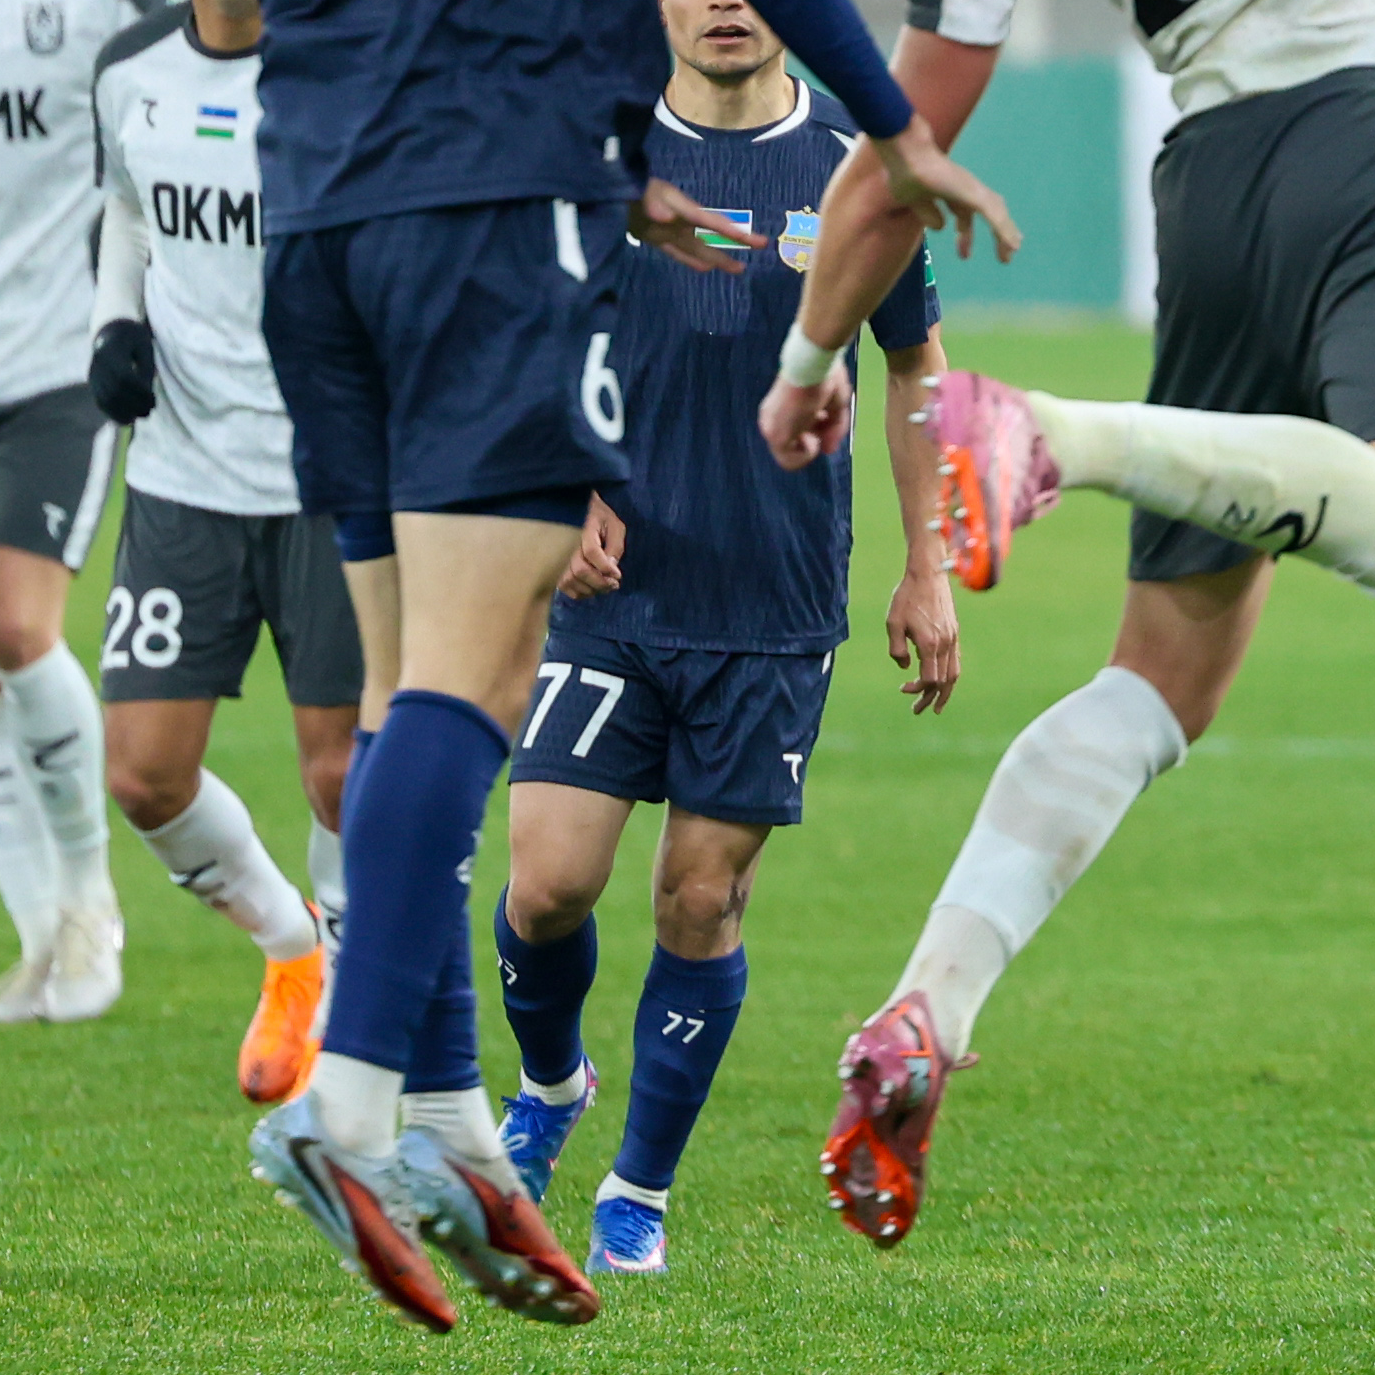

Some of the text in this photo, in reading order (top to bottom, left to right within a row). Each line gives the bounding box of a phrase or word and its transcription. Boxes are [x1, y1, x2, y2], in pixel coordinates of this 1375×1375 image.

[152, 182, 264, 247] OKM
[580, 331, 624, 443] 6
[100, 585, 184, 670] 28
[522, 662, 626, 758] 77
[661, 1010, 705, 1044] 77
